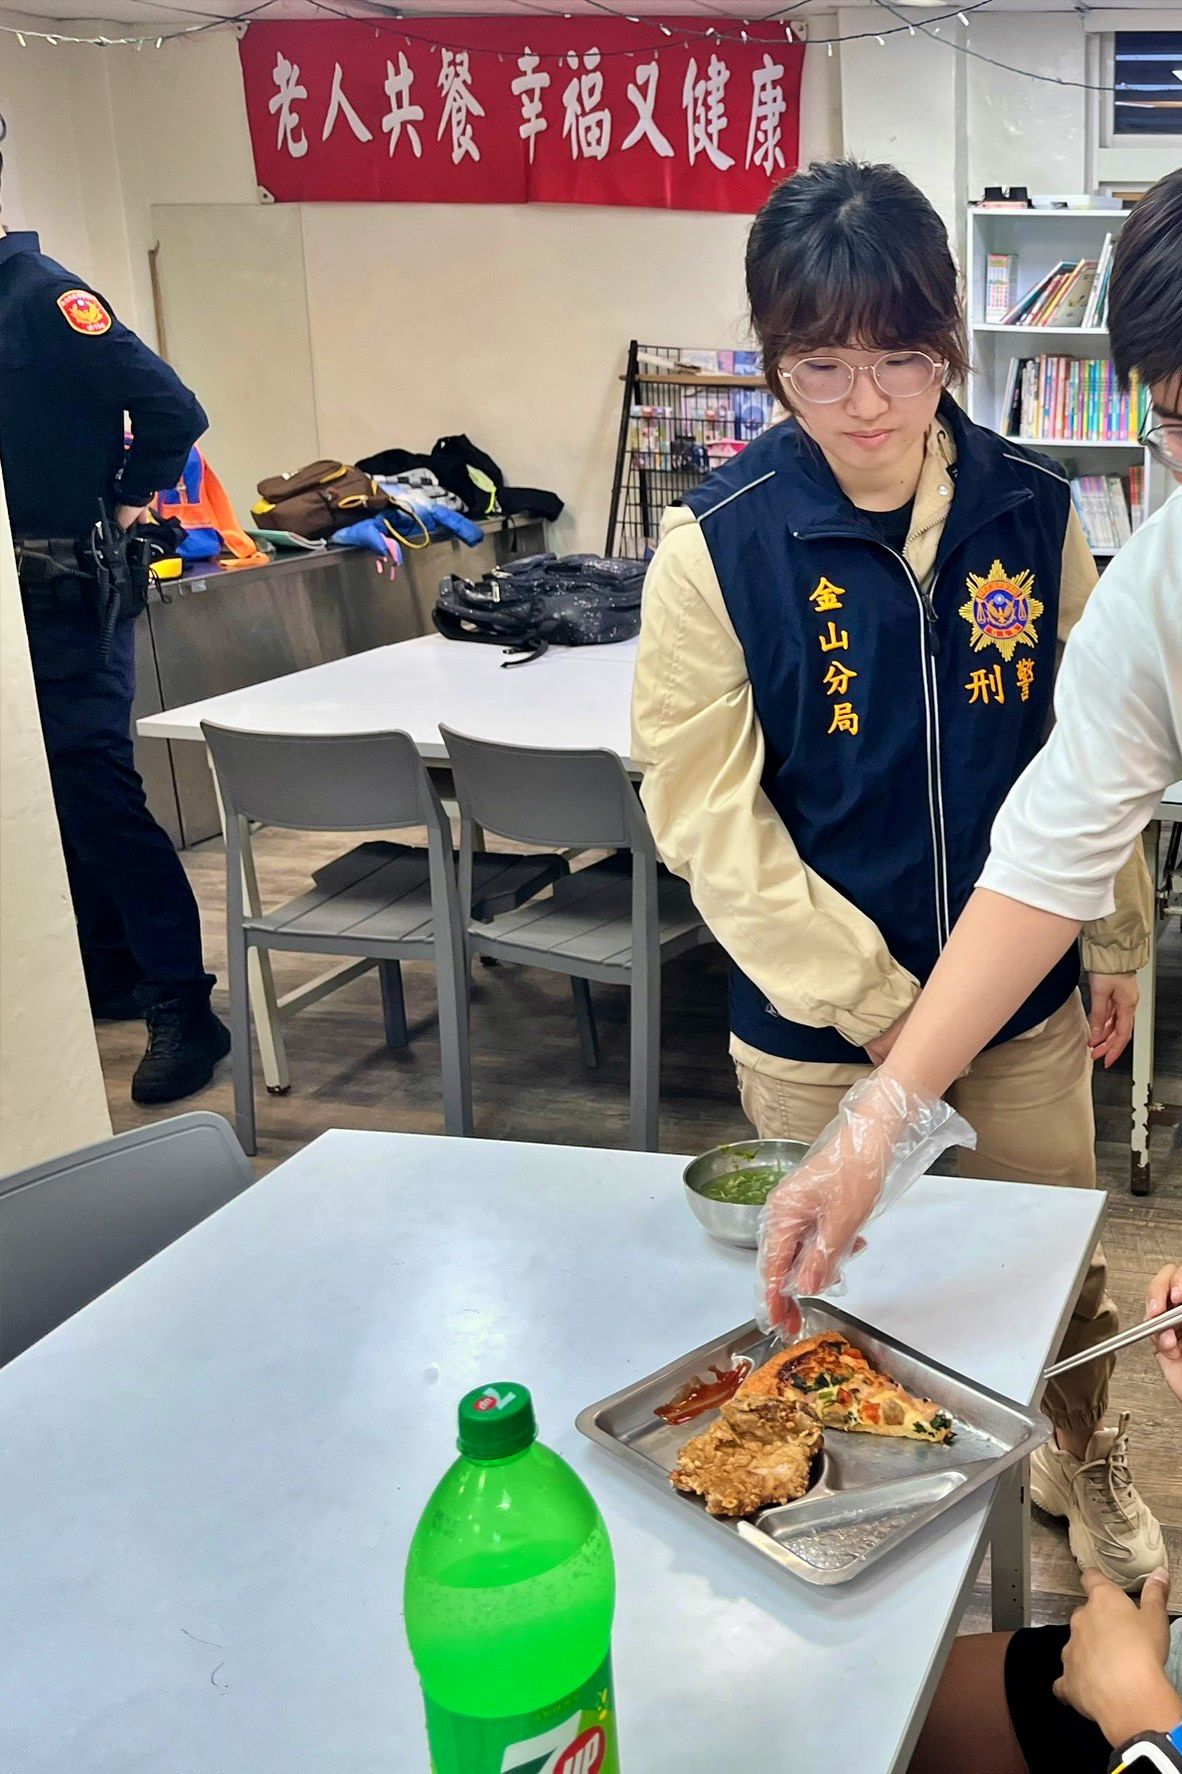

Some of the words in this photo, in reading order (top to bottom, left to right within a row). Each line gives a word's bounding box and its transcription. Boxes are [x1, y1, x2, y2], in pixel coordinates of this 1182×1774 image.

[268, 47, 485, 165] 老人共餐
[510, 46, 787, 177] 幸福又健康
[809, 576, 859, 736] 金山分局
[964, 657, 1035, 705] 刑警
